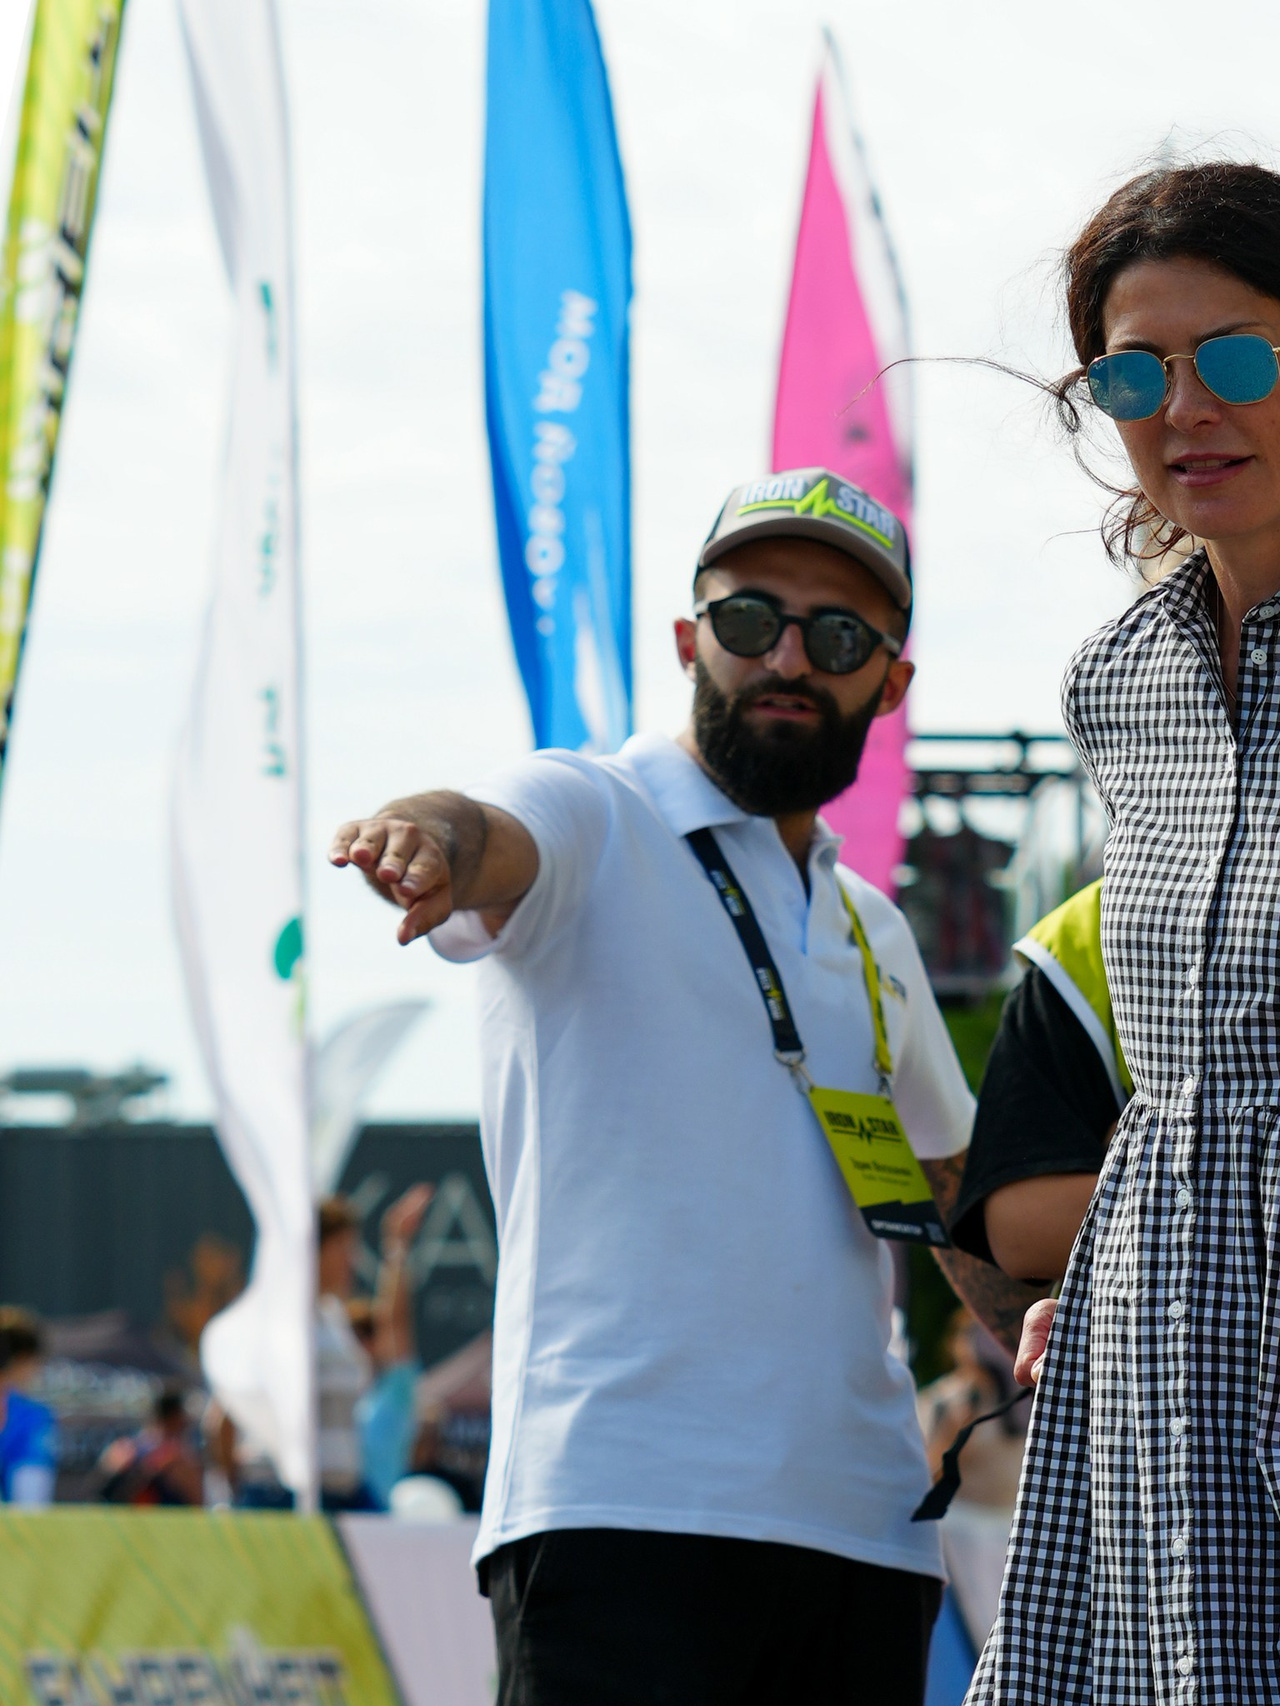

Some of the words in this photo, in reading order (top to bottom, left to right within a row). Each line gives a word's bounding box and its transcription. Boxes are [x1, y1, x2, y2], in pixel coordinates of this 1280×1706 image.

[740, 477, 806, 505] IRON
[837, 485, 897, 540] STAR
[824, 1111, 858, 1129] IRON
[866, 1116, 901, 1136] STAR
